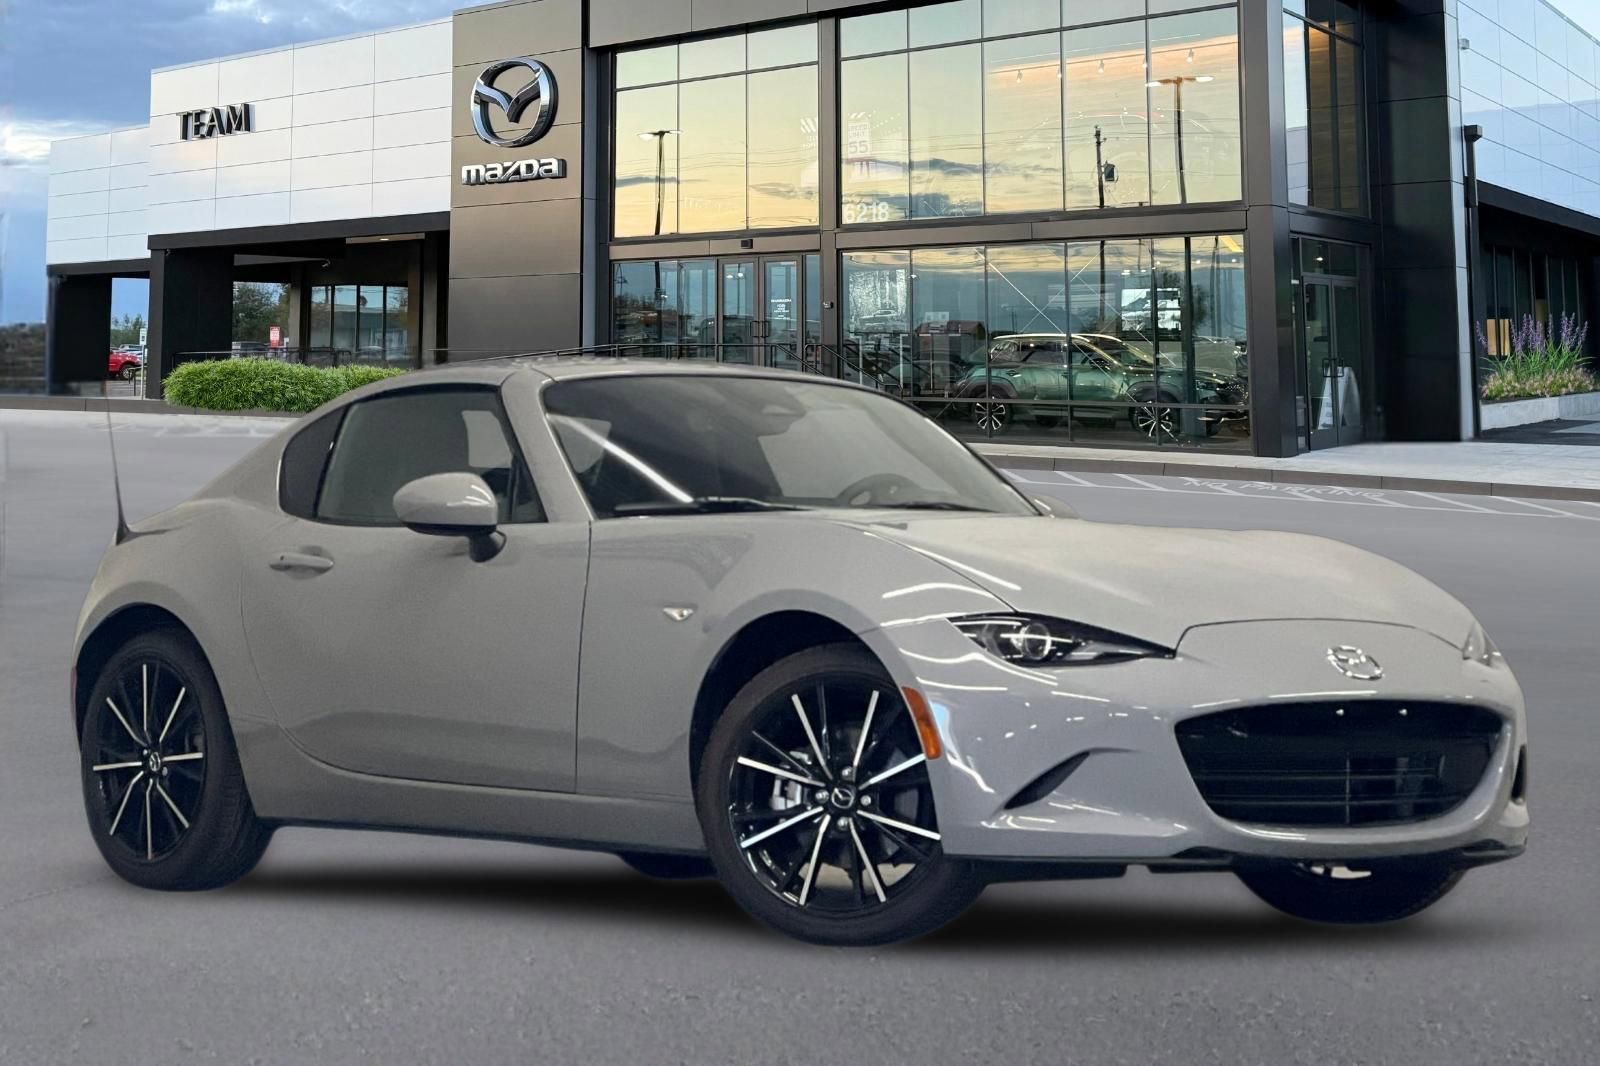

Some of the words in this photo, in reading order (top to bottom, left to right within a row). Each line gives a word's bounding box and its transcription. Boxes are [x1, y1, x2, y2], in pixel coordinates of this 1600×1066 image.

[176, 103, 251, 140] TEAM
[848, 140, 869, 154] 55
[845, 201, 889, 224] 6218
